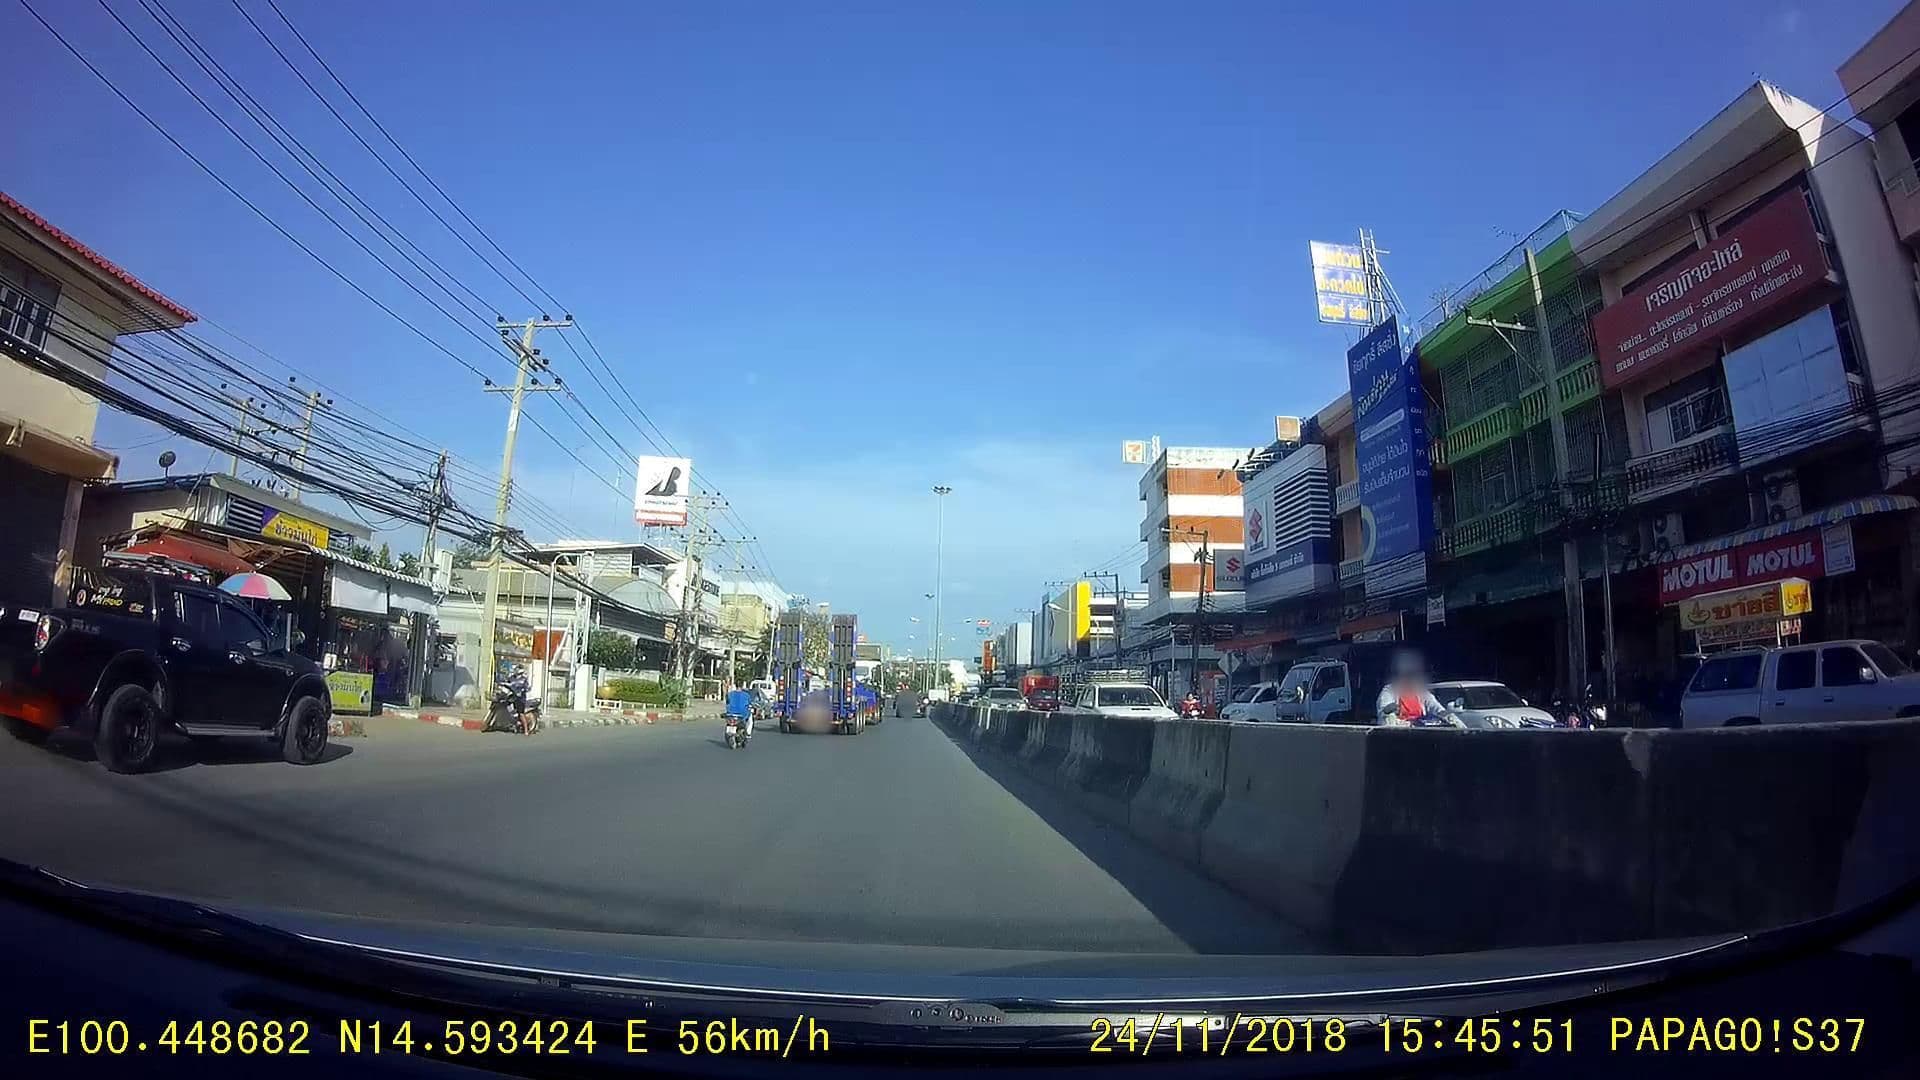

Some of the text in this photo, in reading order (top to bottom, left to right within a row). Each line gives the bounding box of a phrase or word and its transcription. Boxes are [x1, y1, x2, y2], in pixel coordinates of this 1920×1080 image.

[1645, 238, 1743, 312] เจริญกิจอะไหล่
[1662, 554, 1733, 593] MOTUL
[1747, 542, 1816, 577] MOTUL
